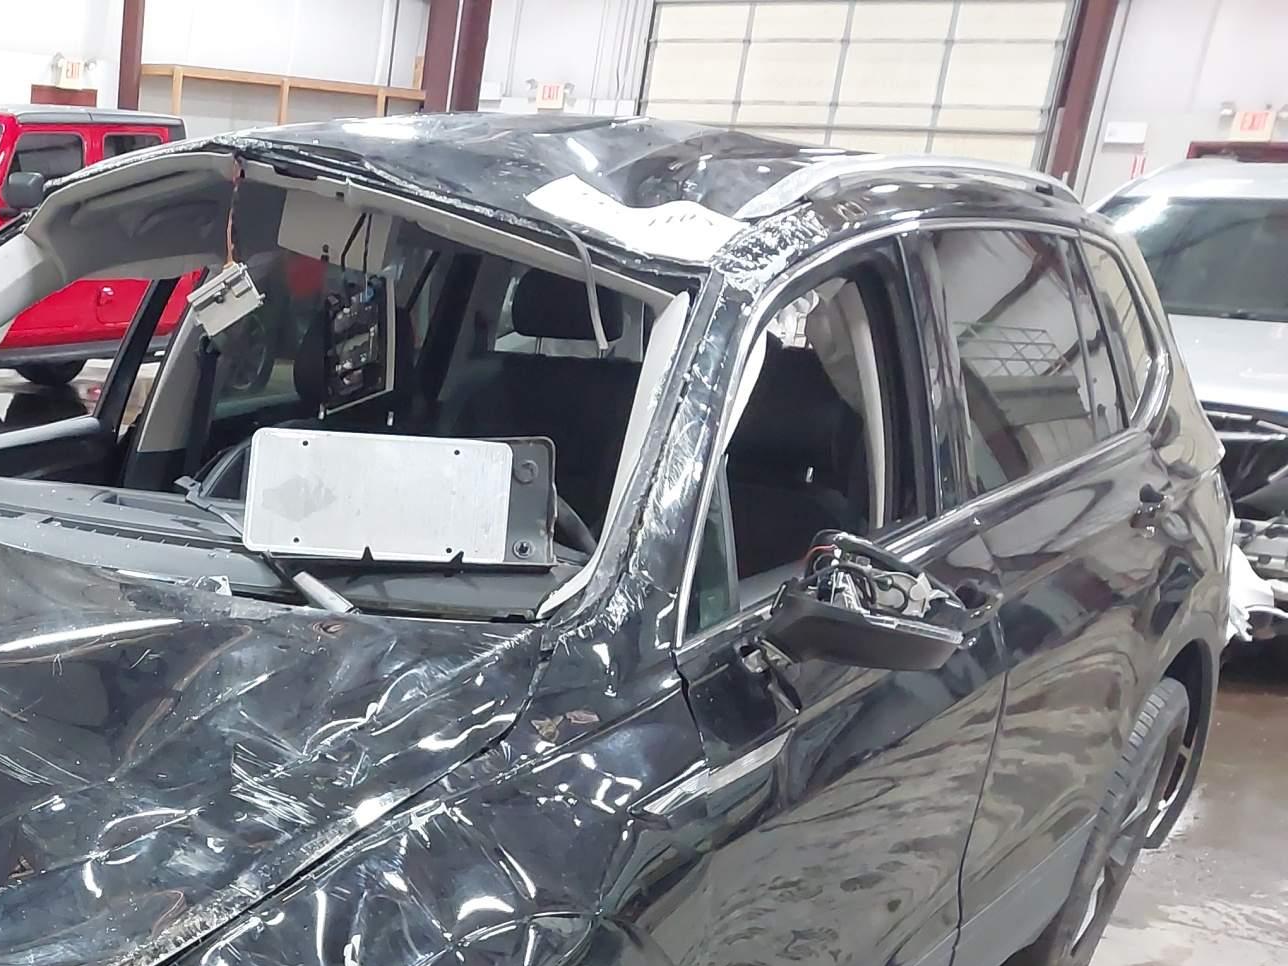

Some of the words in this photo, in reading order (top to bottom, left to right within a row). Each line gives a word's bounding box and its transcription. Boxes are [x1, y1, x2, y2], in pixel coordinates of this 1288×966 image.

[65, 61, 81, 80] EXIT
[542, 85, 560, 101] EXIT
[1239, 111, 1270, 131] EXIT
